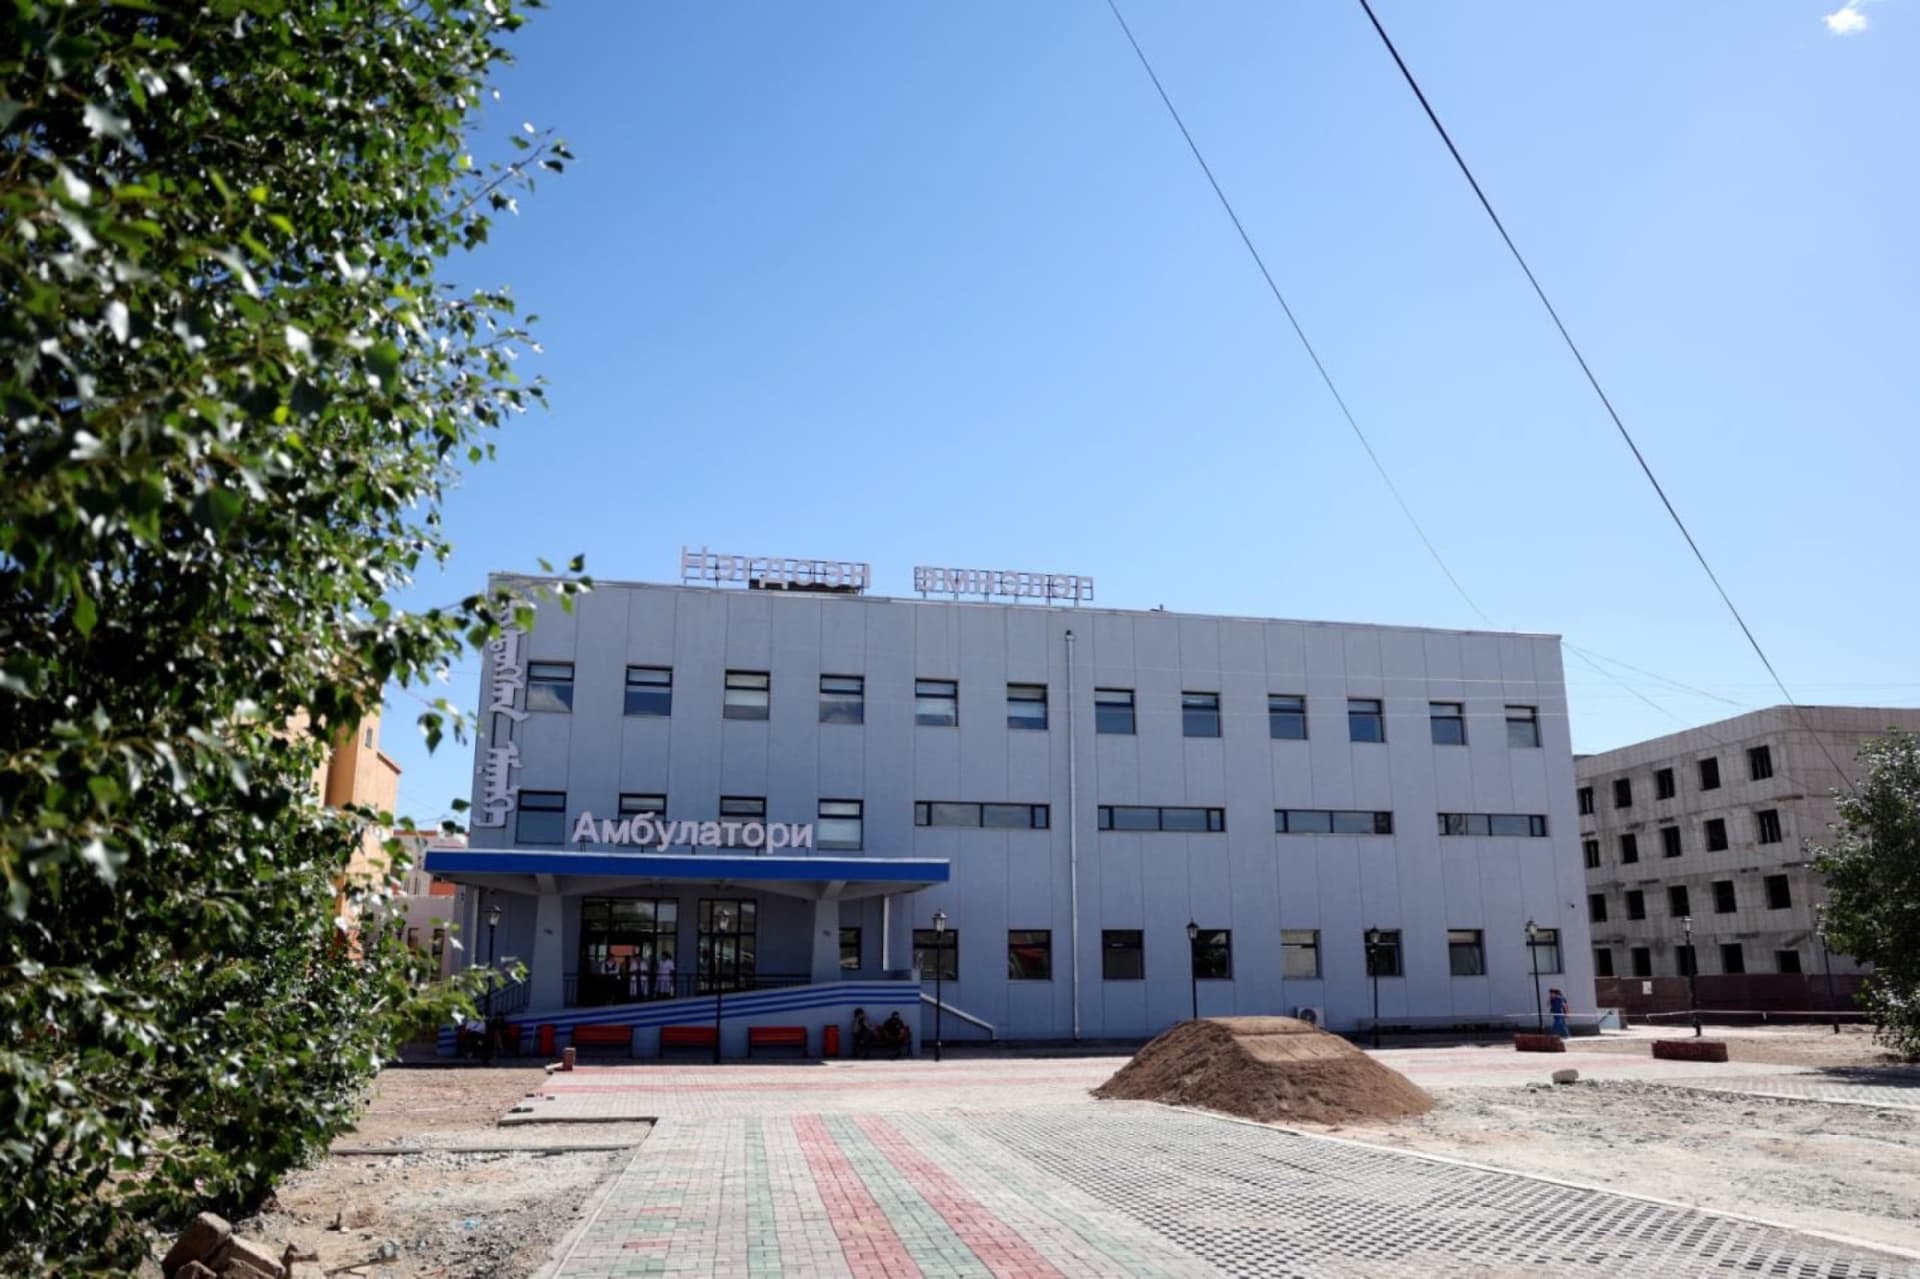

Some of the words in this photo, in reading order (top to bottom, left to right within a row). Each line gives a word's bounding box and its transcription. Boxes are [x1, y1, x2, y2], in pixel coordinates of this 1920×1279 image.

[681, 545, 872, 590] Нэгдсэн
[915, 567, 1093, 600] эмнэлэг
[572, 811, 814, 854] Амбулатори
